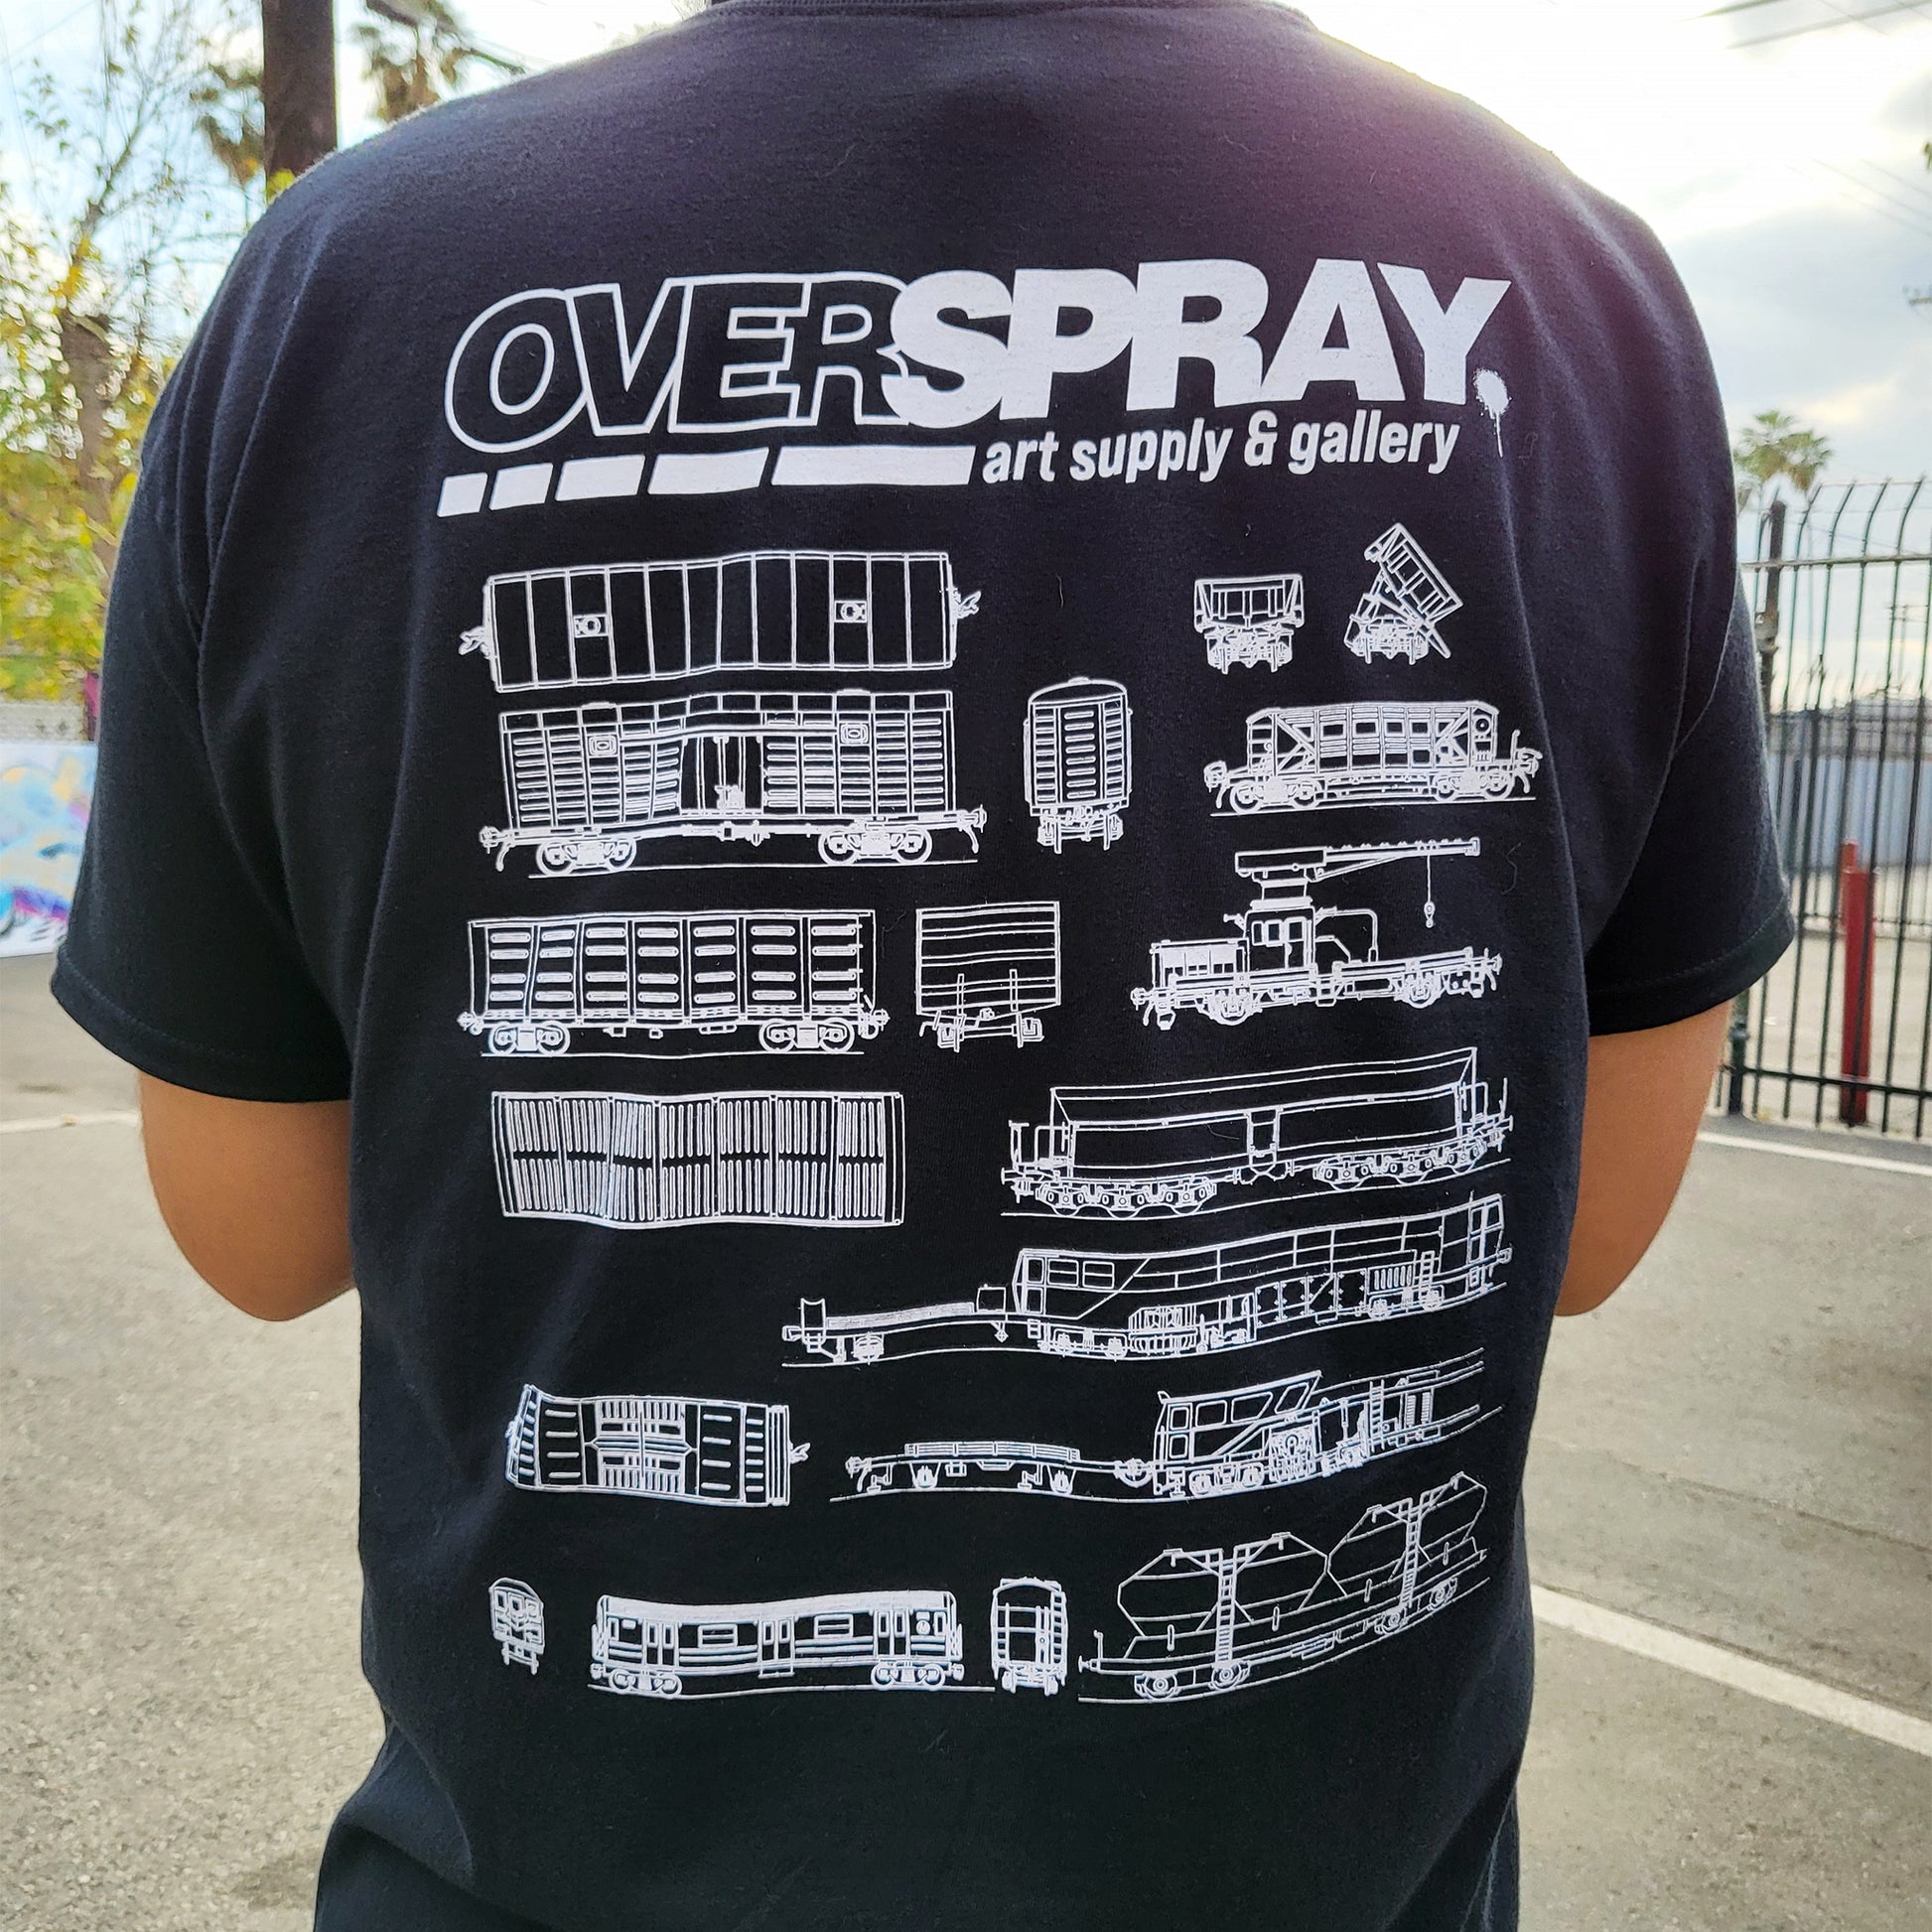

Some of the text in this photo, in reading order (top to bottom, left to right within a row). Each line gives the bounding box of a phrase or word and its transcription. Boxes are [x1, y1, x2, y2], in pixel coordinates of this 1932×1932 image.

[981, 409, 1461, 484] art supply & gallery
